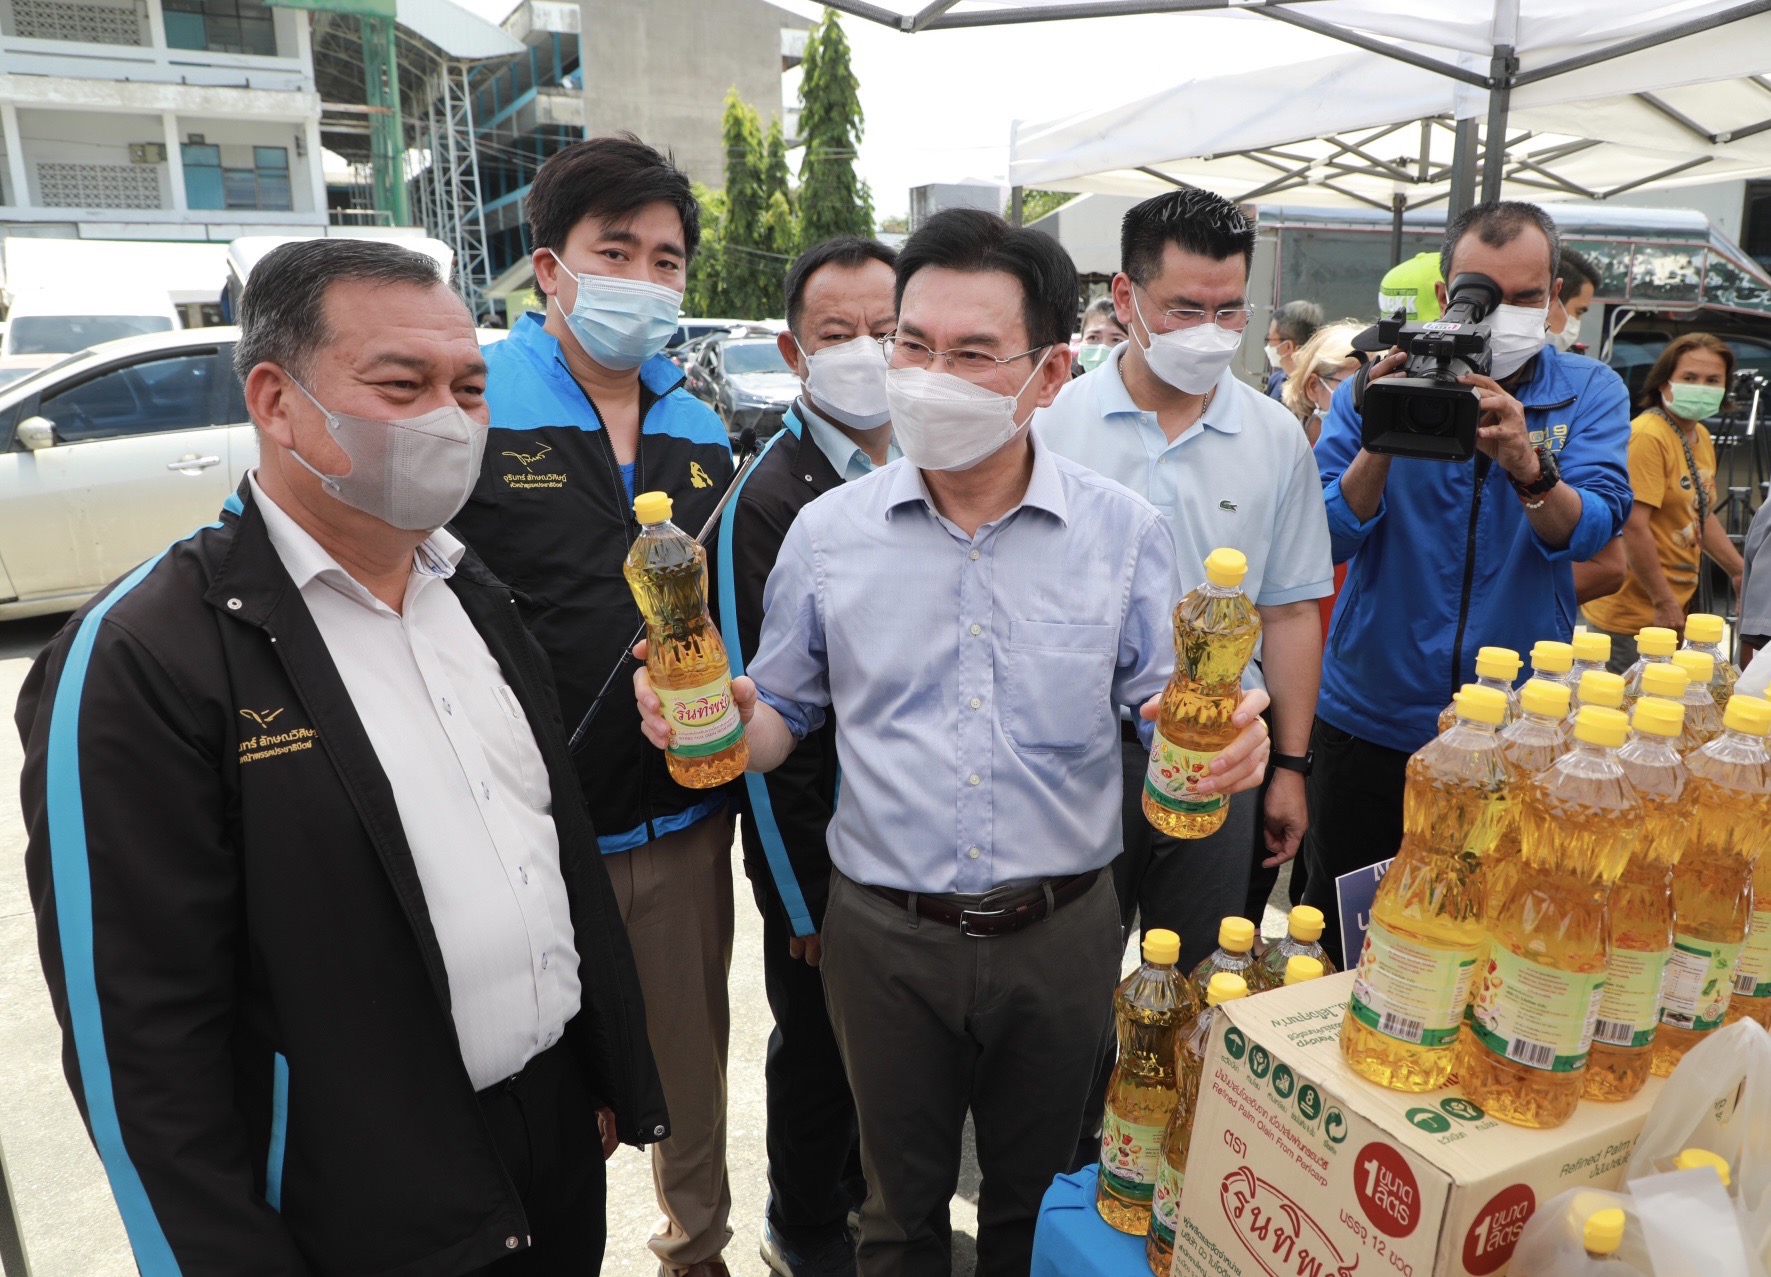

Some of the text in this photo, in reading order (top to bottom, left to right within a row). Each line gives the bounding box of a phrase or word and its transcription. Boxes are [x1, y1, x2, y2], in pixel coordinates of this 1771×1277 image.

[1212, 1082, 1328, 1187] Refined Palm Olein From Pericarp
[1223, 1129, 1247, 1159] ตรา
[1364, 1159, 1379, 1197] 1
[1559, 1140, 1630, 1178] Refined Palm
[1380, 1166, 1413, 1204] ขนาด
[1374, 1185, 1409, 1225] ลิตร
[1492, 1201, 1528, 1230] ขนาด
[1340, 1208, 1413, 1277] บรรจุ 12 ขวด
[1474, 1215, 1491, 1257] 1
[1487, 1222, 1524, 1252] ลิตร
